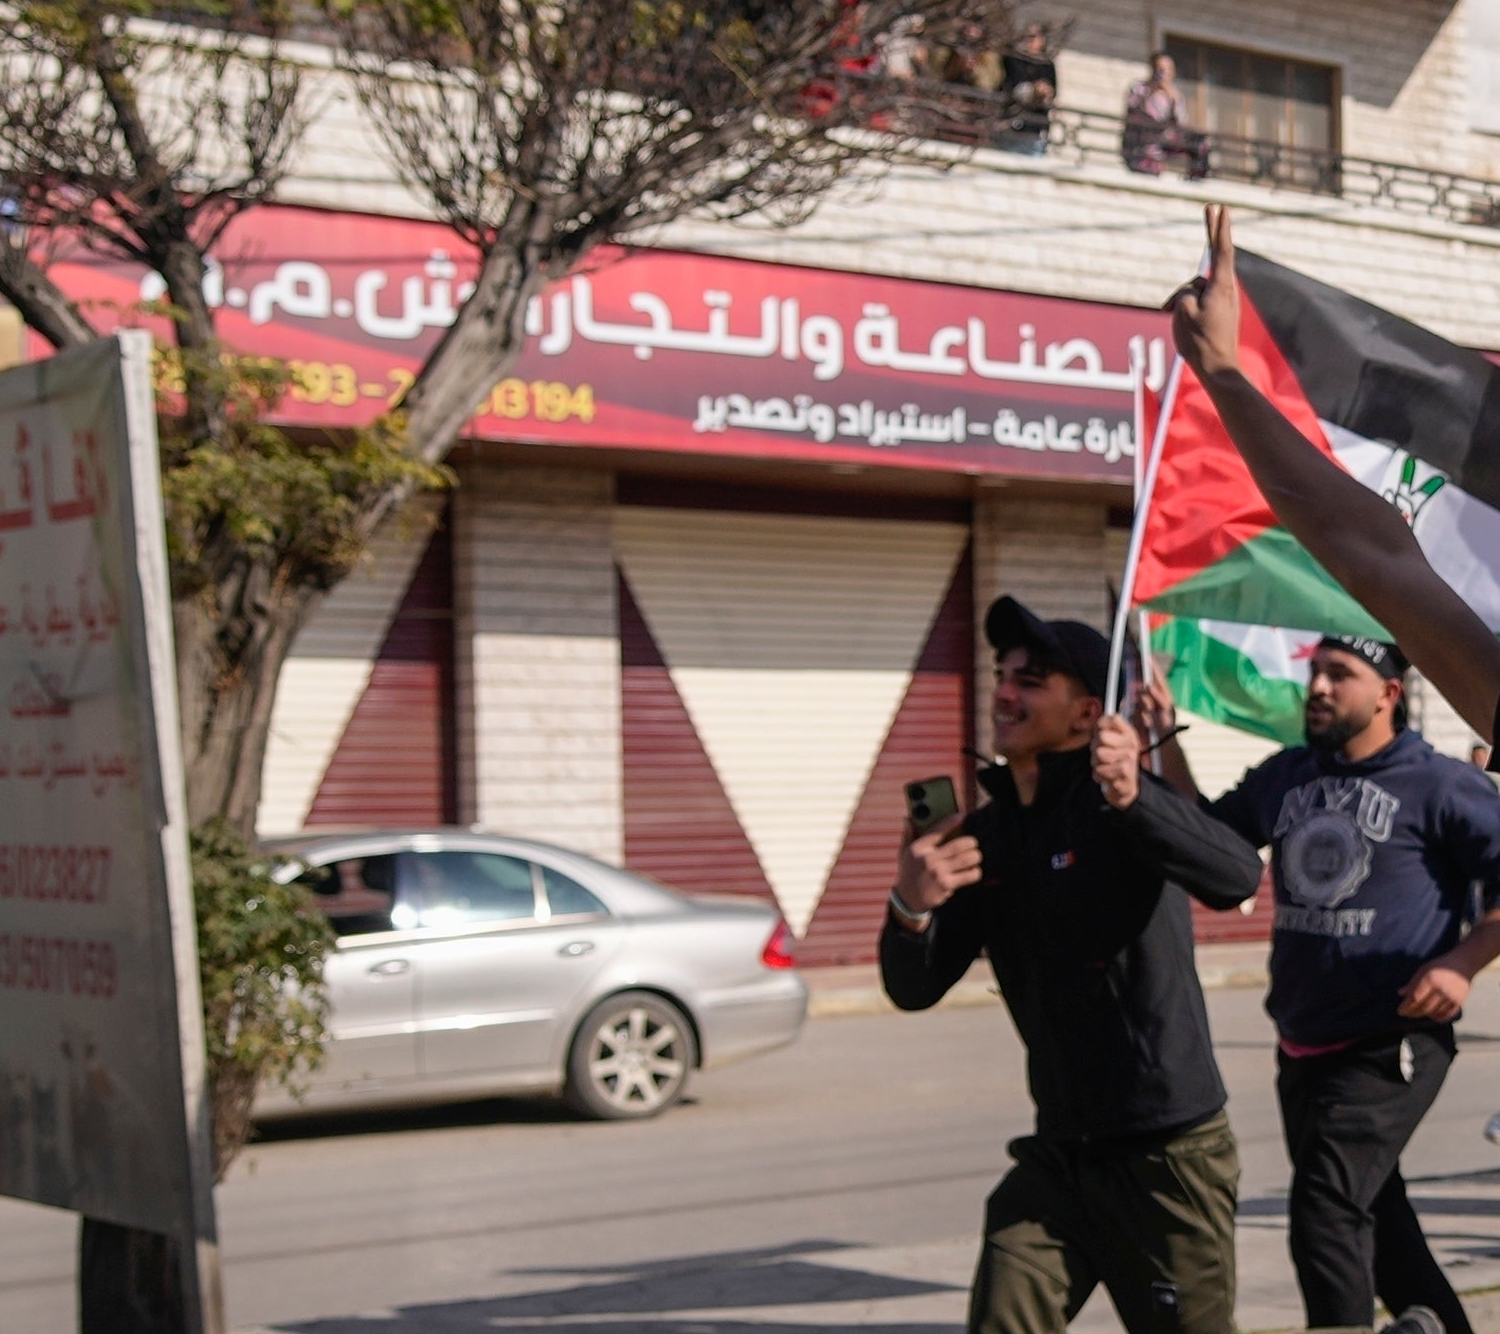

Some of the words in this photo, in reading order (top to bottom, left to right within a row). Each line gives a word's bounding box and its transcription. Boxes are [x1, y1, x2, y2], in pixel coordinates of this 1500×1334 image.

[522, 275, 845, 381] والتجار
[693, 393, 836, 443] وتصدير
[838, 398, 967, 447] استيراد
[993, 407, 1083, 453] عامة
